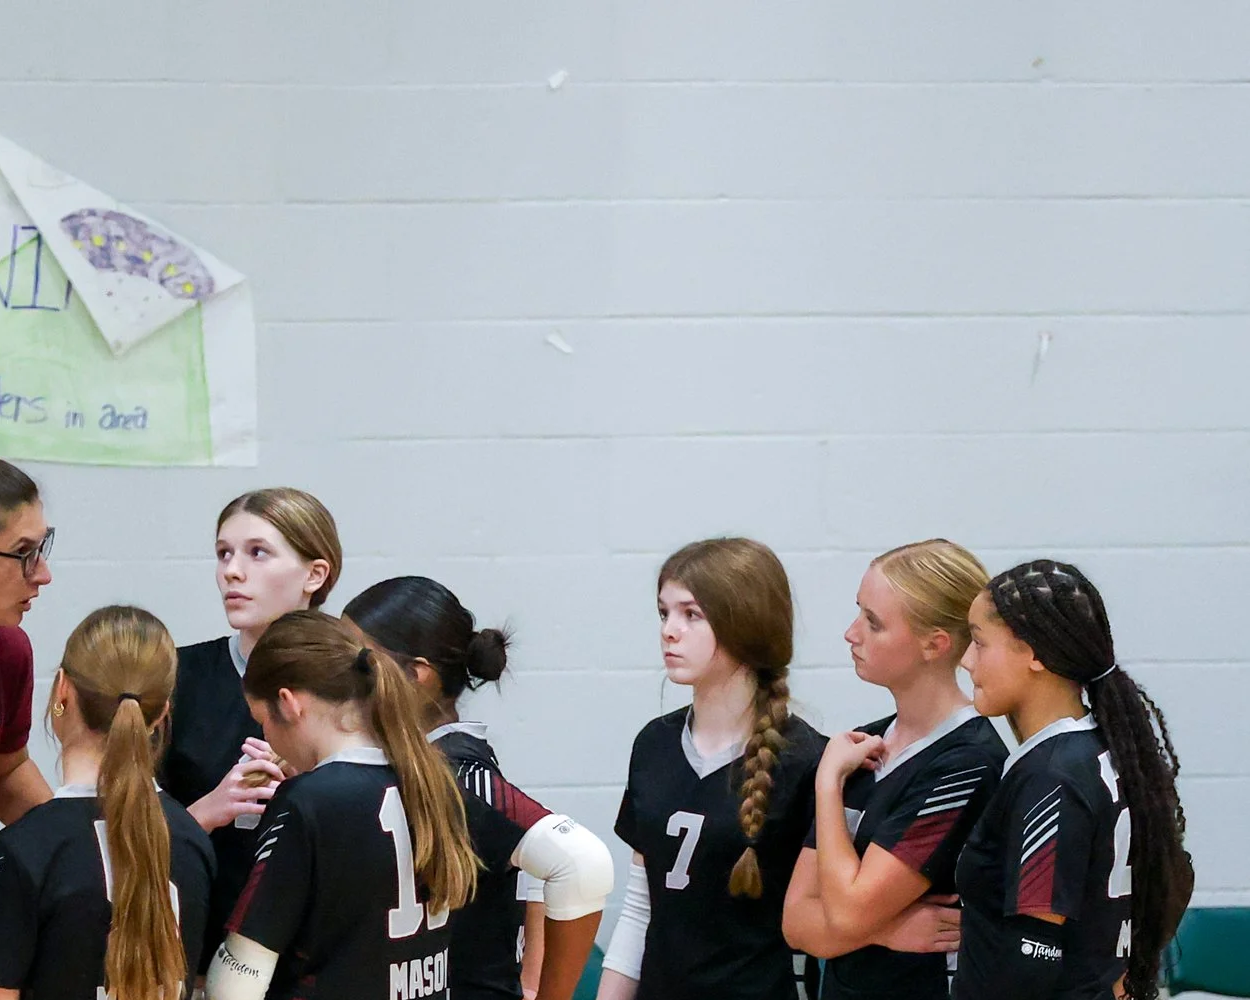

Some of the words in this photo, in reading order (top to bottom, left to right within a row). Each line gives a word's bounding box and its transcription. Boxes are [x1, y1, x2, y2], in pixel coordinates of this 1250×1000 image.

[65, 400, 84, 428] in
[98, 403, 149, 430] area
[378, 785, 449, 939] 1
[665, 810, 705, 890] 7
